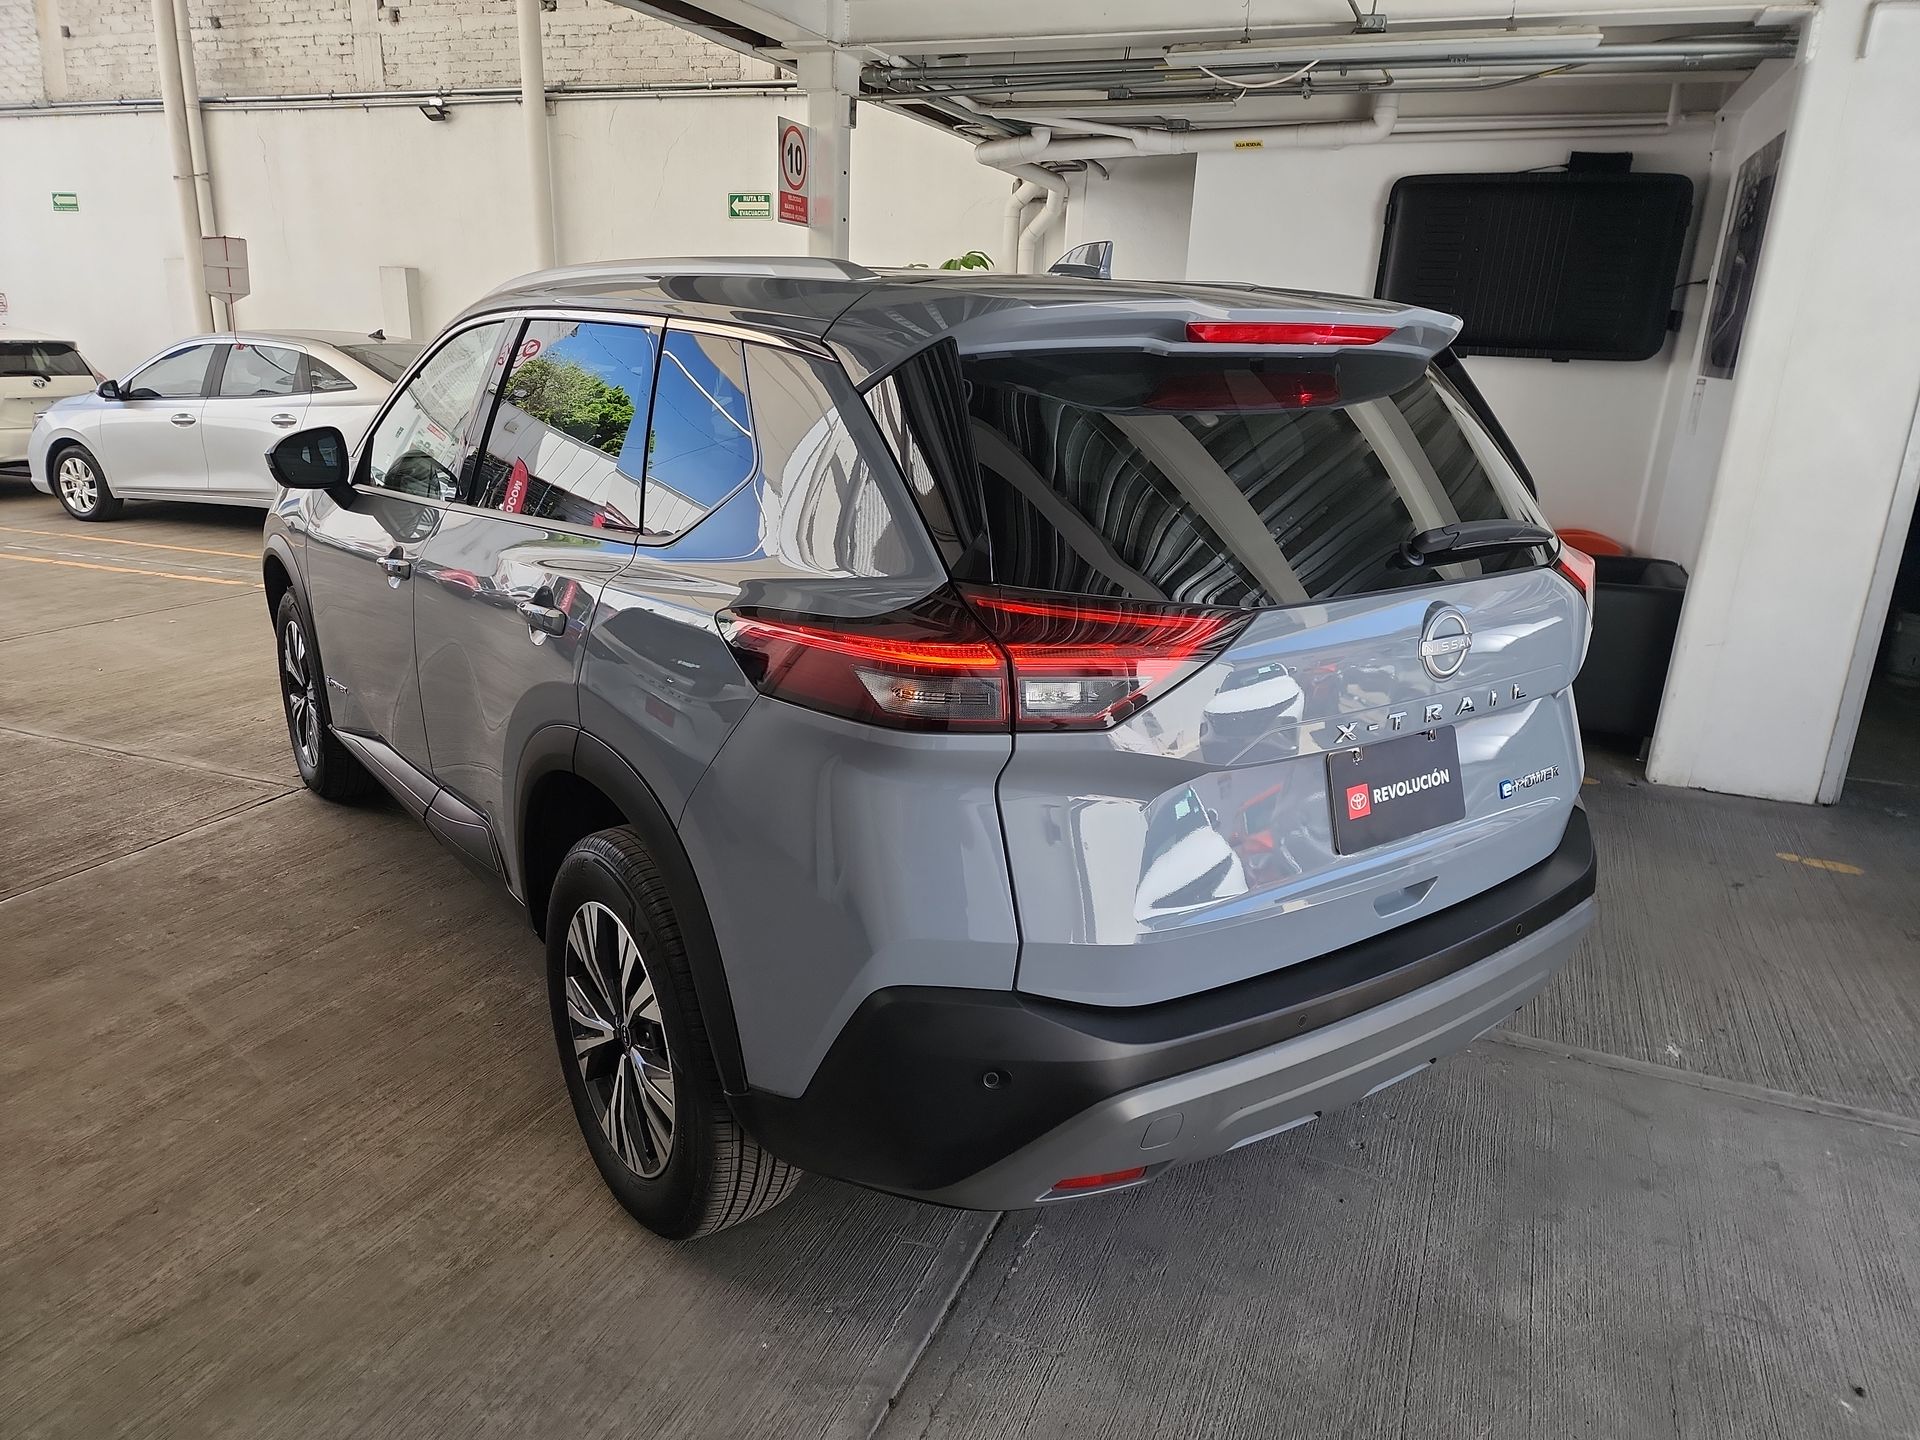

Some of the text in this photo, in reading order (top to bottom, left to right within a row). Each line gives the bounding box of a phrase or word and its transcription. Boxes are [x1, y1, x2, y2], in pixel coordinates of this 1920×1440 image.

[787, 142, 802, 176] 10
[1423, 636, 1472, 654] NISSAN
[1334, 682, 1526, 744] X-TRAIL
[1372, 767, 1450, 804] REVOLUCIÓN
